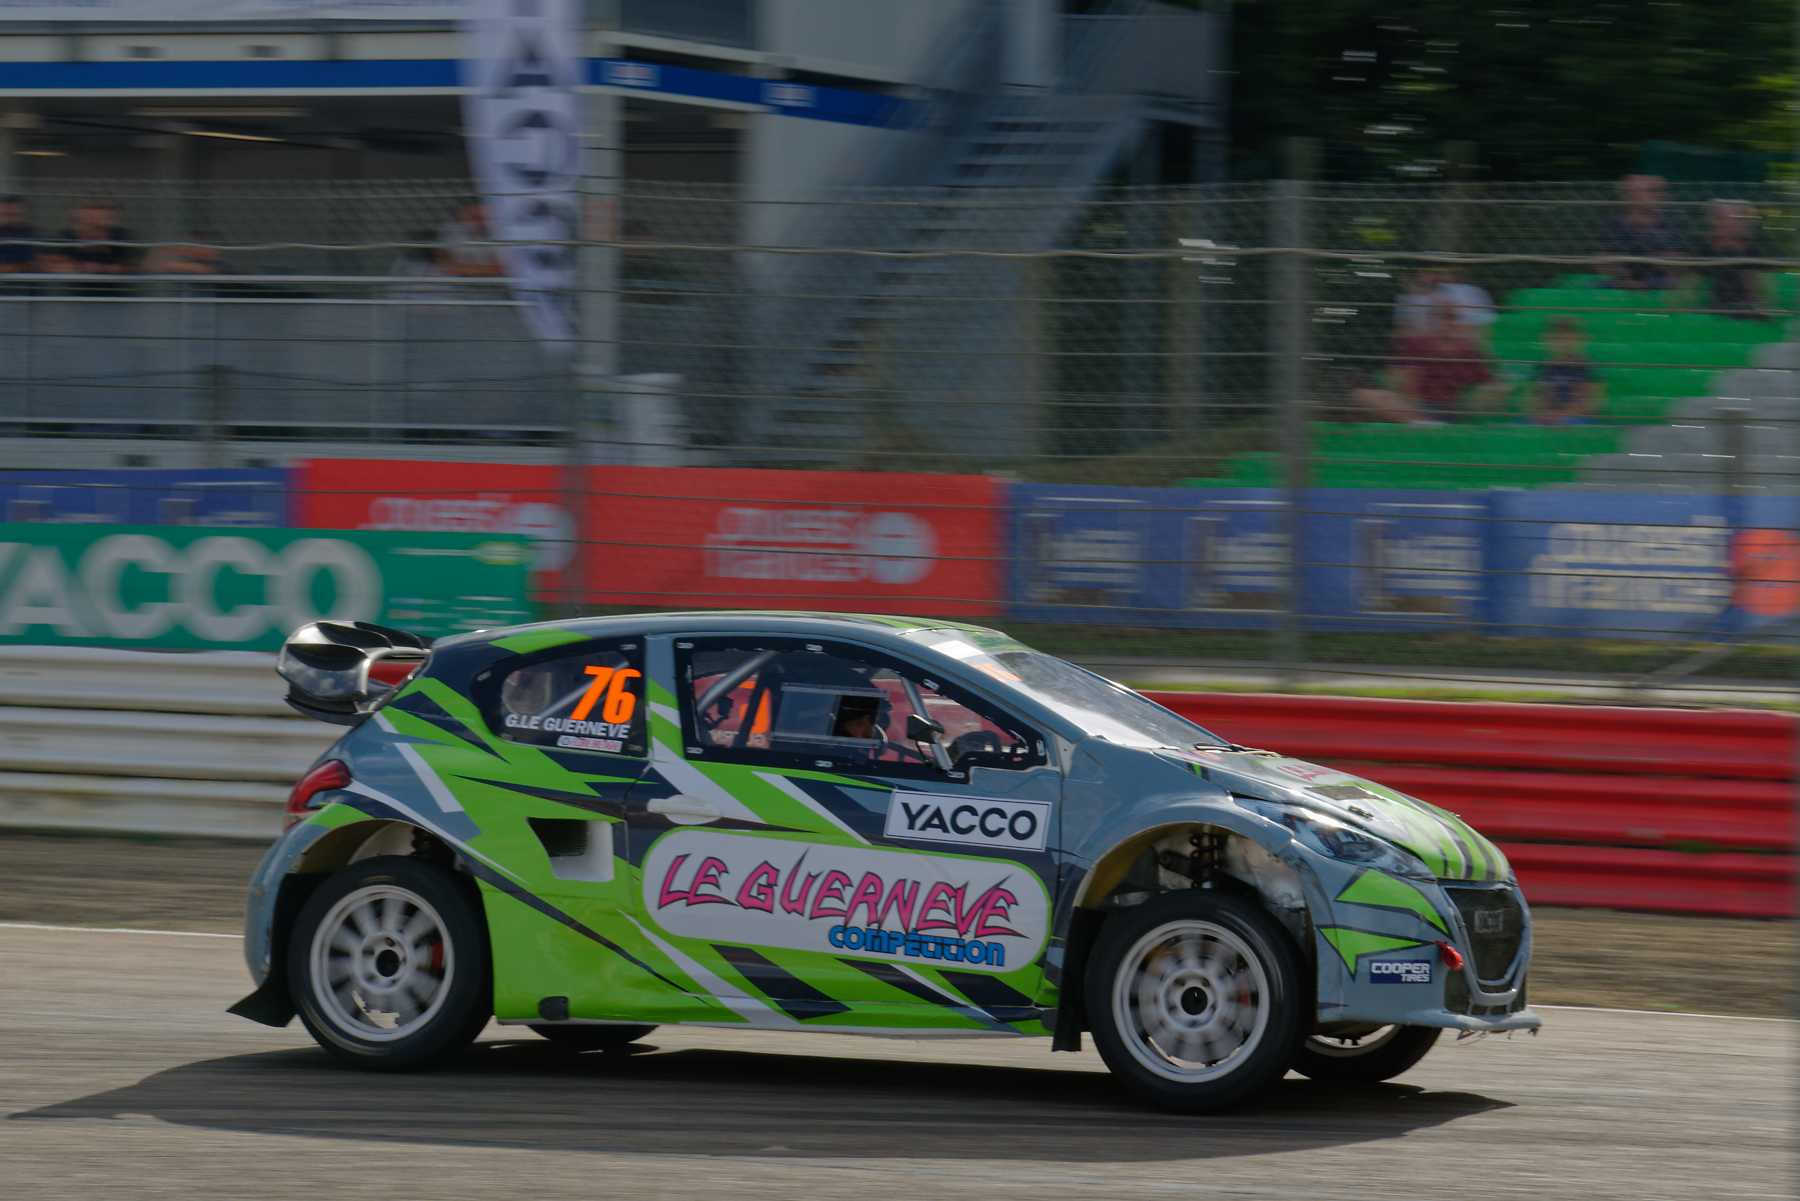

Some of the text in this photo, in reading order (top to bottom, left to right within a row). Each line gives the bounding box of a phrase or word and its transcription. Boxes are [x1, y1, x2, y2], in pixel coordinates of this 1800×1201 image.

[570, 665, 642, 724] 76
[543, 716, 631, 739] GUERNEVE
[901, 802, 1038, 842] YACCO
[657, 847, 1031, 940] LE GUERNEVE
[1371, 962, 1430, 974] COOPER
[1400, 973, 1430, 982] TIRES
